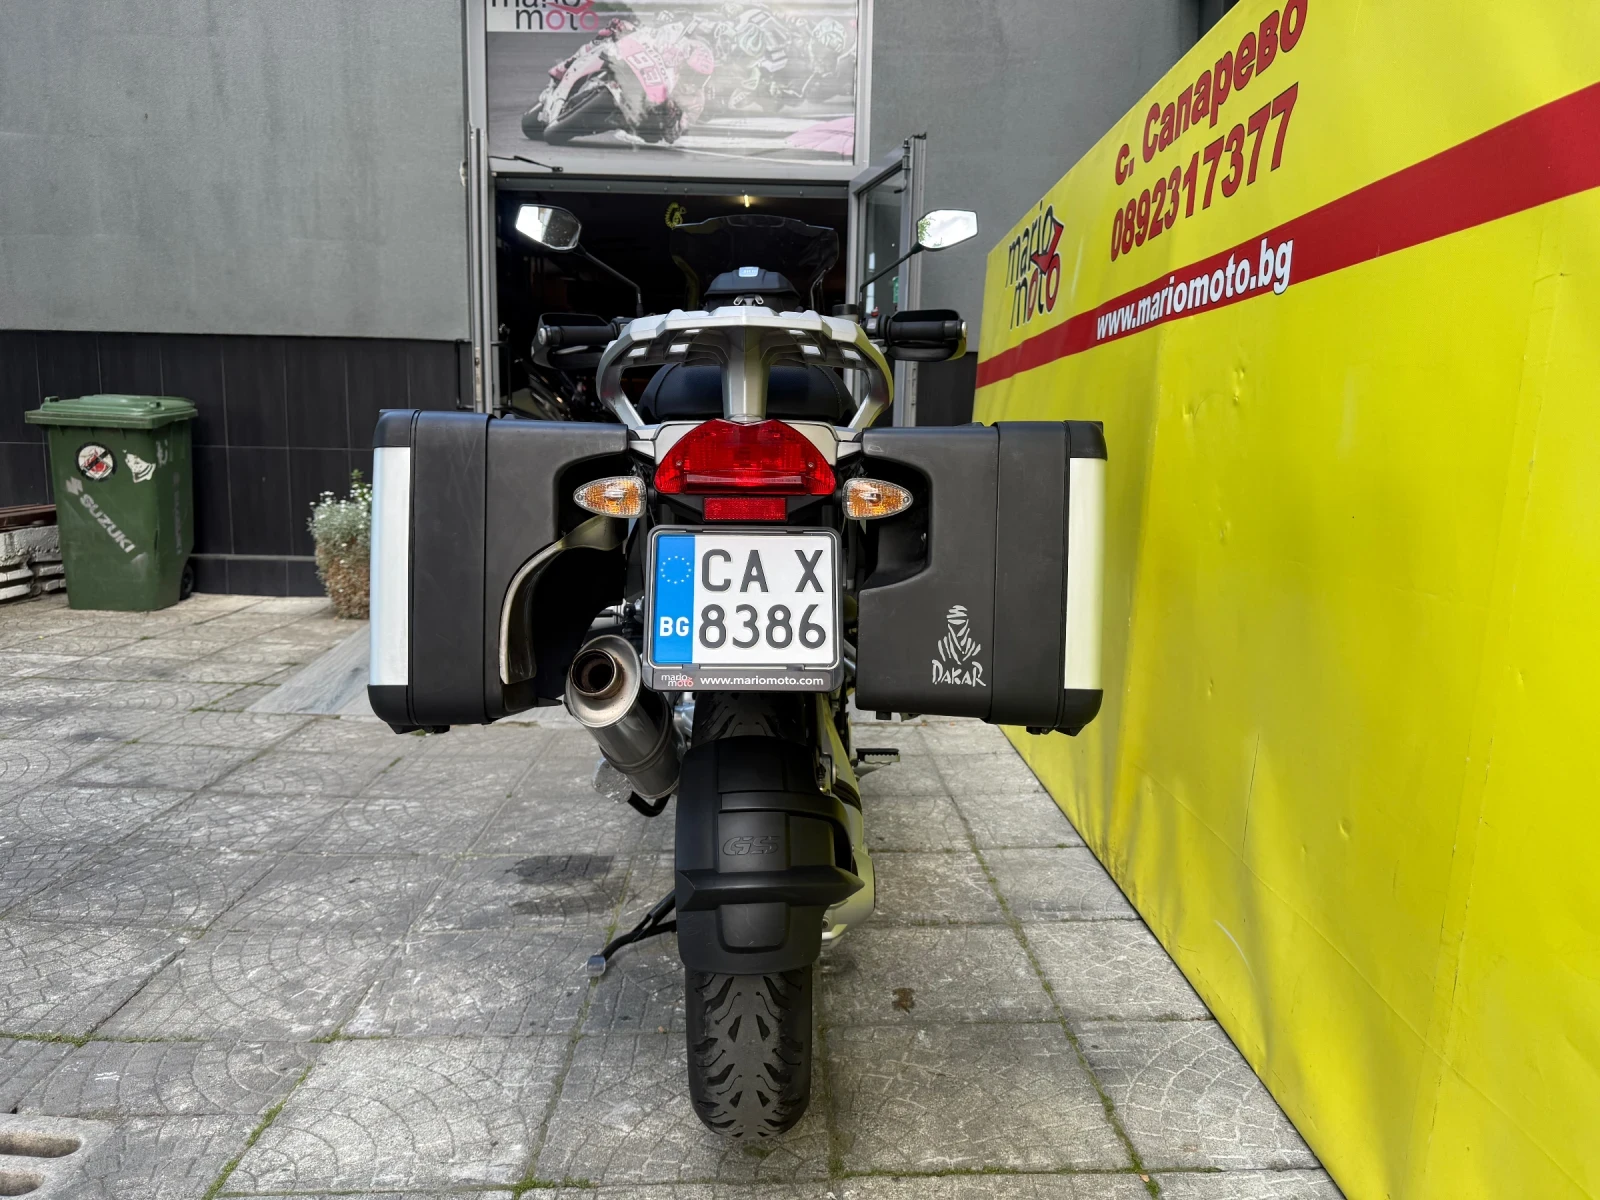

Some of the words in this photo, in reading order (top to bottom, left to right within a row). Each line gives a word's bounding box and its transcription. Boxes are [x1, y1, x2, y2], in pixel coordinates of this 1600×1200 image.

[516, 9, 599, 31] moto
[1115, 143, 1135, 186] с.
[1142, 0, 1309, 163] Сапарево
[1111, 82, 1299, 262] 0892317377
[1005, 200, 1054, 288] mario
[1010, 252, 1061, 330] moto
[1096, 237, 1294, 341] www.mariomoto.bg
[79, 493, 136, 553] SUZUKI
[701, 548, 769, 593] CA
[794, 549, 825, 593] X
[659, 616, 690, 637] BG
[699, 603, 827, 649] 8386
[700, 675, 824, 686] www.mariomoto.com
[931, 659, 987, 687] DAKAR
[722, 835, 781, 857] GS
